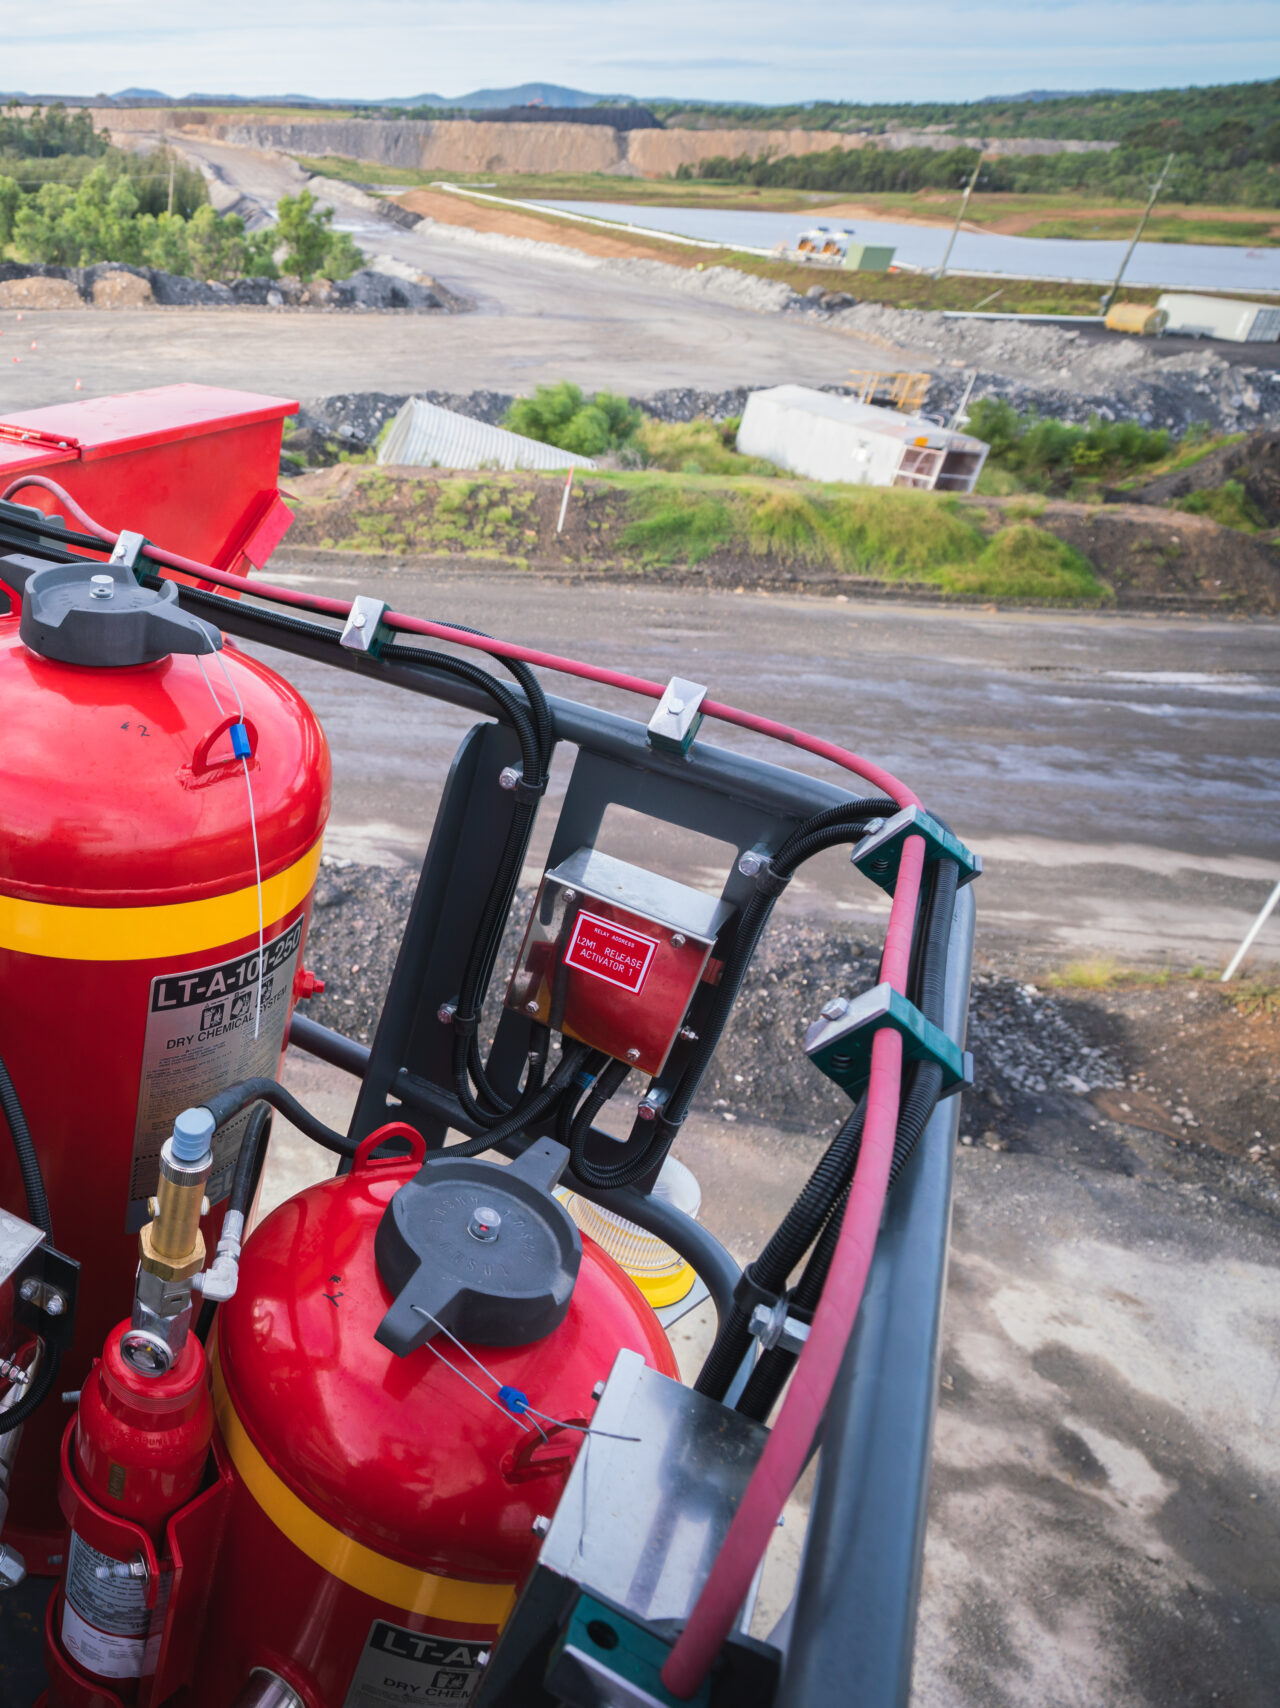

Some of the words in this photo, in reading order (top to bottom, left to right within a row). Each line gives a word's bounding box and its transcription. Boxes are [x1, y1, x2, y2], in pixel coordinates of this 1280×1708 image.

[576, 935, 597, 950] L2M1
[603, 946, 643, 970] RELEASE
[593, 927, 610, 938] RELAY
[611, 935, 635, 949] ADDRESS
[156, 924, 302, 1008] LT-A-101-250
[579, 948, 625, 974] ACTIVATOR
[628, 968, 633, 977] 1
[166, 1035, 195, 1050] DRY
[197, 1013, 255, 1043] CHEMICAL
[259, 985, 288, 1016] SYSTEM
[382, 1677, 422, 1693] DRY
